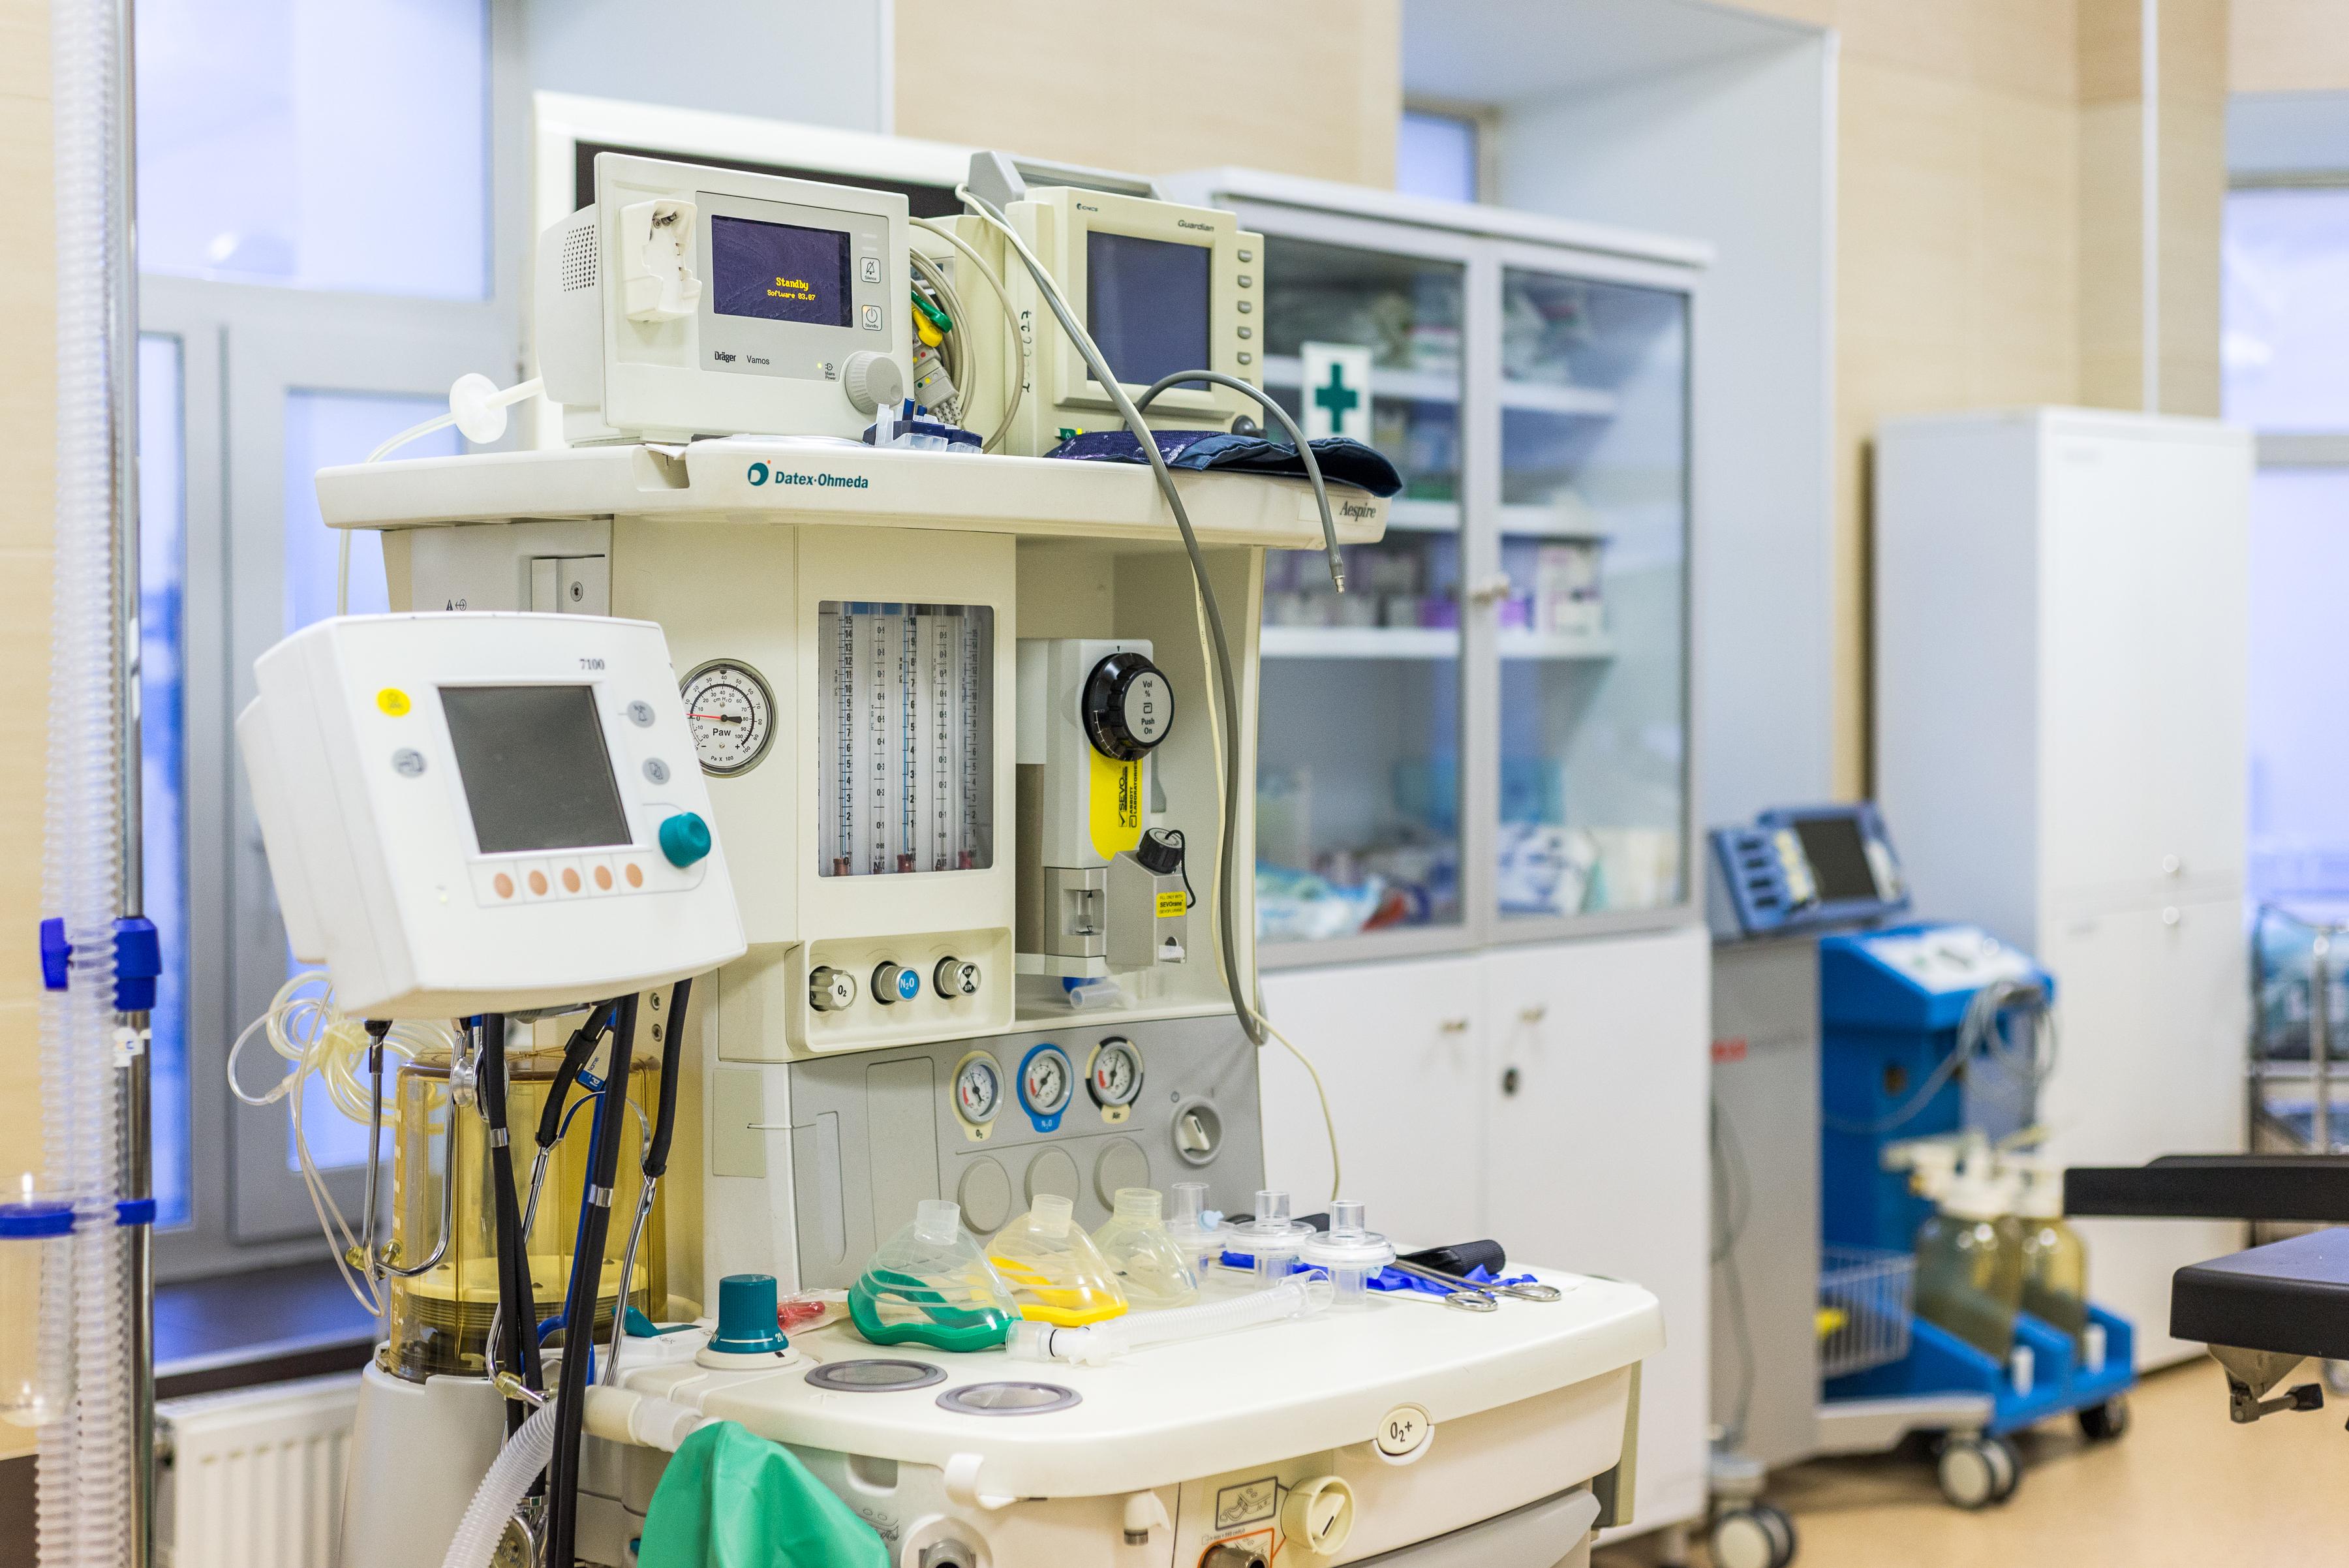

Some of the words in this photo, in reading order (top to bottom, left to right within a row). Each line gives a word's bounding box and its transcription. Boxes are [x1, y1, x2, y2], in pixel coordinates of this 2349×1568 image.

[1178, 219, 1214, 232] Guardian
[776, 277, 808, 291] Standby
[767, 289, 795, 298] Software
[714, 351, 736, 363] Dräger
[746, 355, 770, 365] Vamos
[1340, 501, 1376, 521] Aespire
[845, 616, 852, 624] 15
[910, 617, 916, 626] 10
[845, 630, 852, 638] 14
[911, 638, 915, 646] 9
[845, 643, 852, 652] 13
[579, 659, 605, 670] 7100
[845, 656, 852, 666] 12
[911, 658, 915, 666] 8
[846, 670, 852, 679] 11
[911, 679, 915, 687] 7
[845, 684, 852, 693] 10
[846, 699, 851, 707] 9
[911, 700, 915, 709] 6
[846, 713, 851, 722] 8
[846, 728, 851, 737] 7
[846, 760, 851, 768] 5
[846, 776, 851, 785] 4
[910, 795, 914, 803] 2
[972, 810, 976, 819] 2
[911, 820, 914, 828] 1
[775, 1332, 783, 1343] 20
